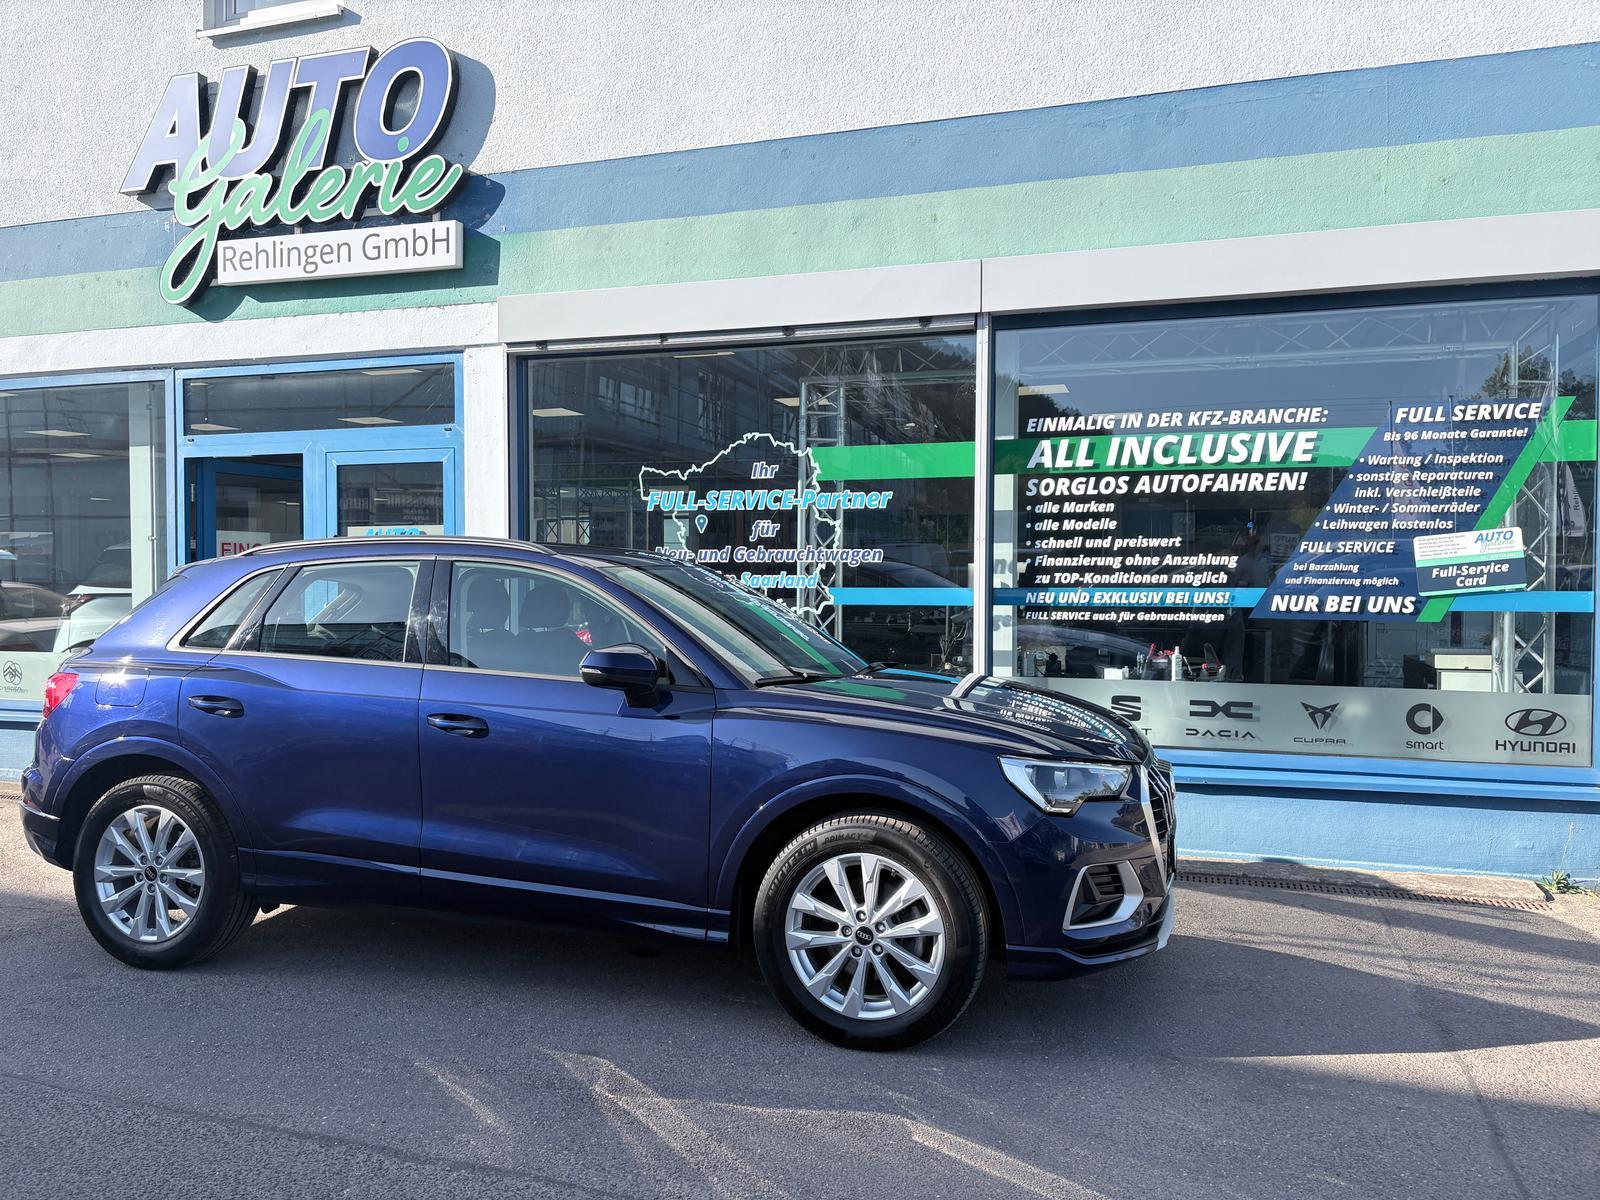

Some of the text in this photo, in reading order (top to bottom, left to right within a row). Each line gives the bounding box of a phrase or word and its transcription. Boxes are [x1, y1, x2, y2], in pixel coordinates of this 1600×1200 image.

[119, 37, 457, 194] AUTO
[222, 227, 451, 273] Rehlingen GmbH
[1026, 407, 1329, 433] EINMALIG IN DER KFZ-BRANCHE:
[1394, 402, 1542, 424] FULL SERVICE
[1383, 427, 1528, 442] Bis 96 Monate Garantie!
[1026, 431, 1319, 469] ALL INCLUSIVE
[1367, 454, 1423, 467] Wartung
[1434, 452, 1504, 467] Inspektion
[750, 461, 780, 480] Ihr
[1356, 469, 1494, 484] sonstige Reparaturen
[1026, 471, 1309, 498] SORGLOS AUTOFAHREN!
[646, 488, 894, 512] FULL-SERVICE-Partner
[1354, 485, 1482, 500] inkl. Verschleißteile
[1034, 500, 1115, 515] alle Marken
[1333, 503, 1380, 514] Winter-
[1391, 501, 1481, 514] Sommerräder
[749, 519, 780, 542] für
[1034, 518, 1118, 532] alle Modelle
[1322, 518, 1454, 532] Leihwagen kostenlos
[1034, 535, 1182, 551] schnell und preiswert
[1474, 530, 1514, 543] AUTO
[222, 542, 262, 556] EIN
[1299, 541, 1395, 553] FULL SERVICE
[697, 547, 732, 563] und
[734, 546, 884, 565] Gebrauchtwagen
[1034, 553, 1239, 570] Finanzierung ohne Anzahlung
[1293, 562, 1360, 574] bei Barzahlung
[1432, 562, 1510, 579] Full-Service
[739, 571, 819, 589] Saarland
[1034, 570, 1228, 587] zu TOP-Konditionen möglich
[1285, 576, 1399, 587] und Finanzierung möglich
[1456, 574, 1488, 588] Card
[1025, 591, 1231, 604] NEU UND EXKLUSIV BEI UNS!
[1270, 594, 1417, 613] NUR BEI UNS
[1025, 611, 1225, 623] FULL SERVICE auch für Gebrauchtwagen
[1185, 728, 1256, 739] DACIA
[1405, 740, 1445, 751] smart
[1495, 739, 1577, 754] HYUNDAI
